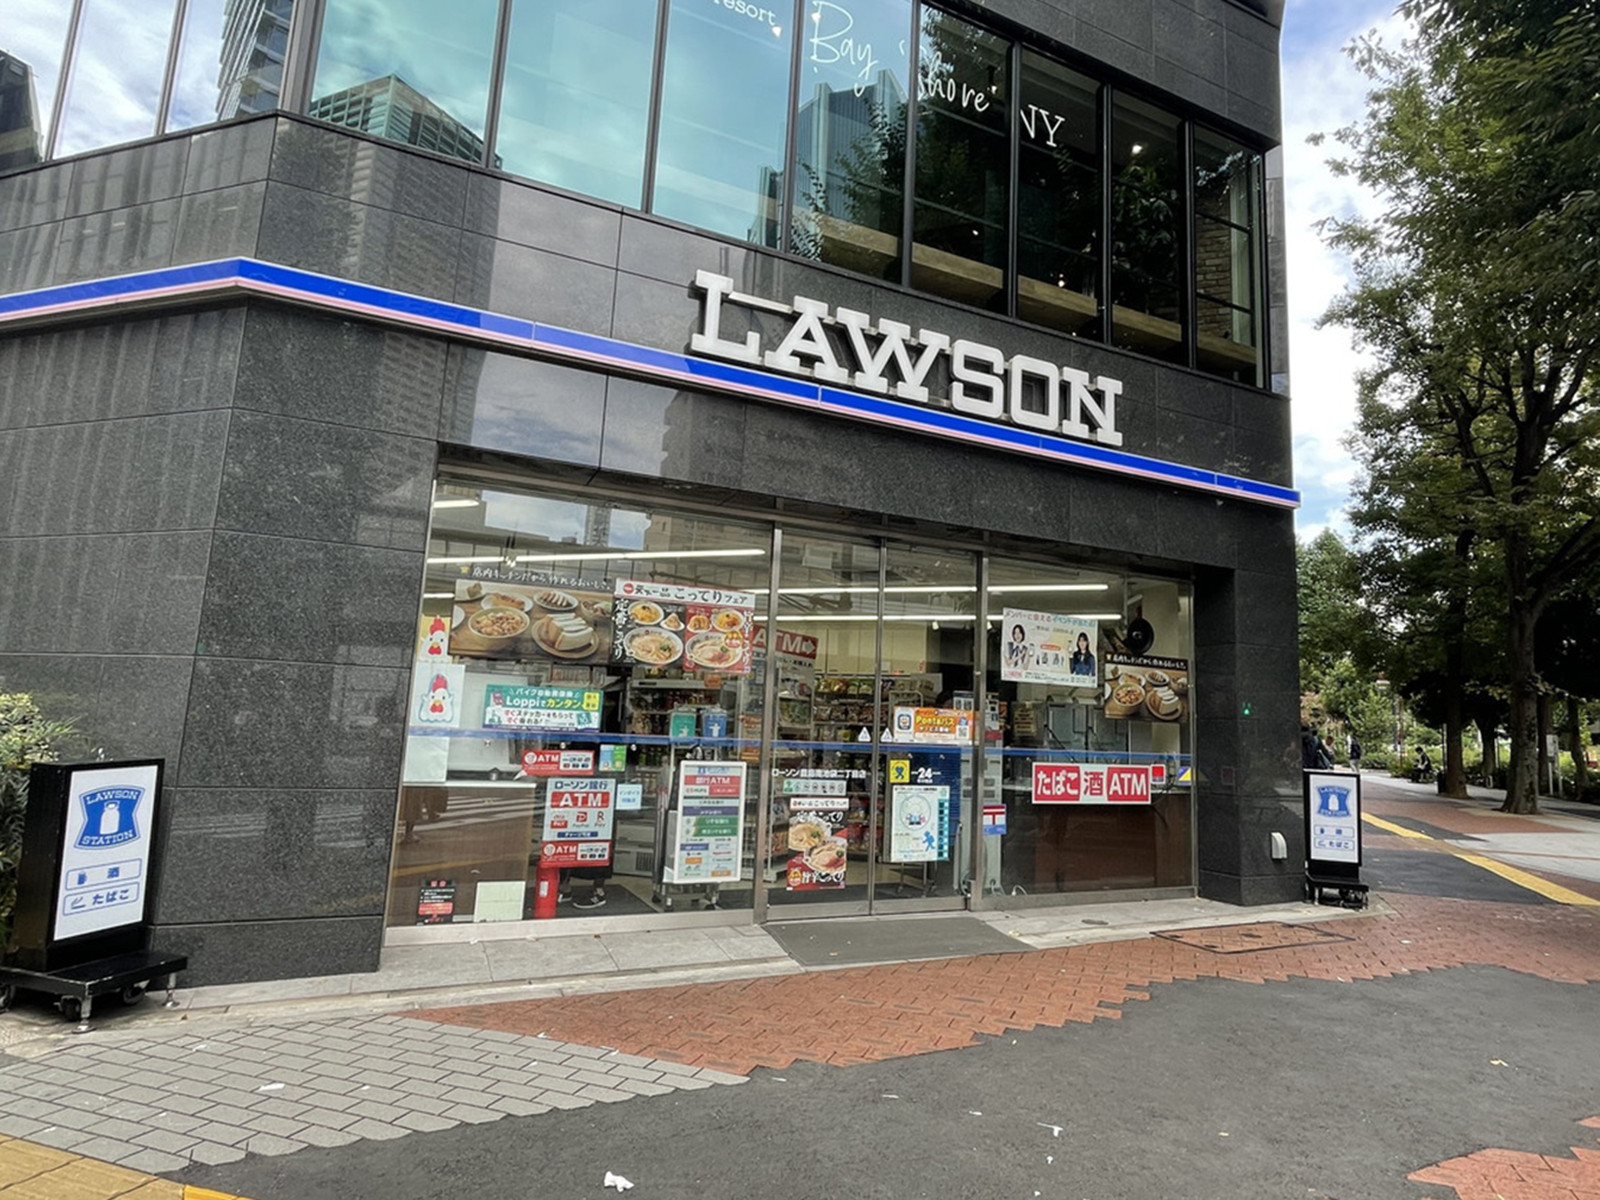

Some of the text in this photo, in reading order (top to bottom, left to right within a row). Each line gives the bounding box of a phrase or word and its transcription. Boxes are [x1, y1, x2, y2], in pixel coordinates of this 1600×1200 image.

[809, 1, 878, 97] Bay
[690, 269, 1123, 447] LAWSON
[537, 754, 560, 763] ATM
[917, 767, 933, 779] 24
[554, 780, 608, 790] ローソン銀行
[1037, 769, 1147, 796] たばこ 酒 ATM
[86, 789, 139, 805] LAWSON
[559, 792, 602, 807] ATM
[81, 829, 134, 846] STATION
[555, 845, 577, 854] ATM
[92, 889, 130, 906] たばこ
